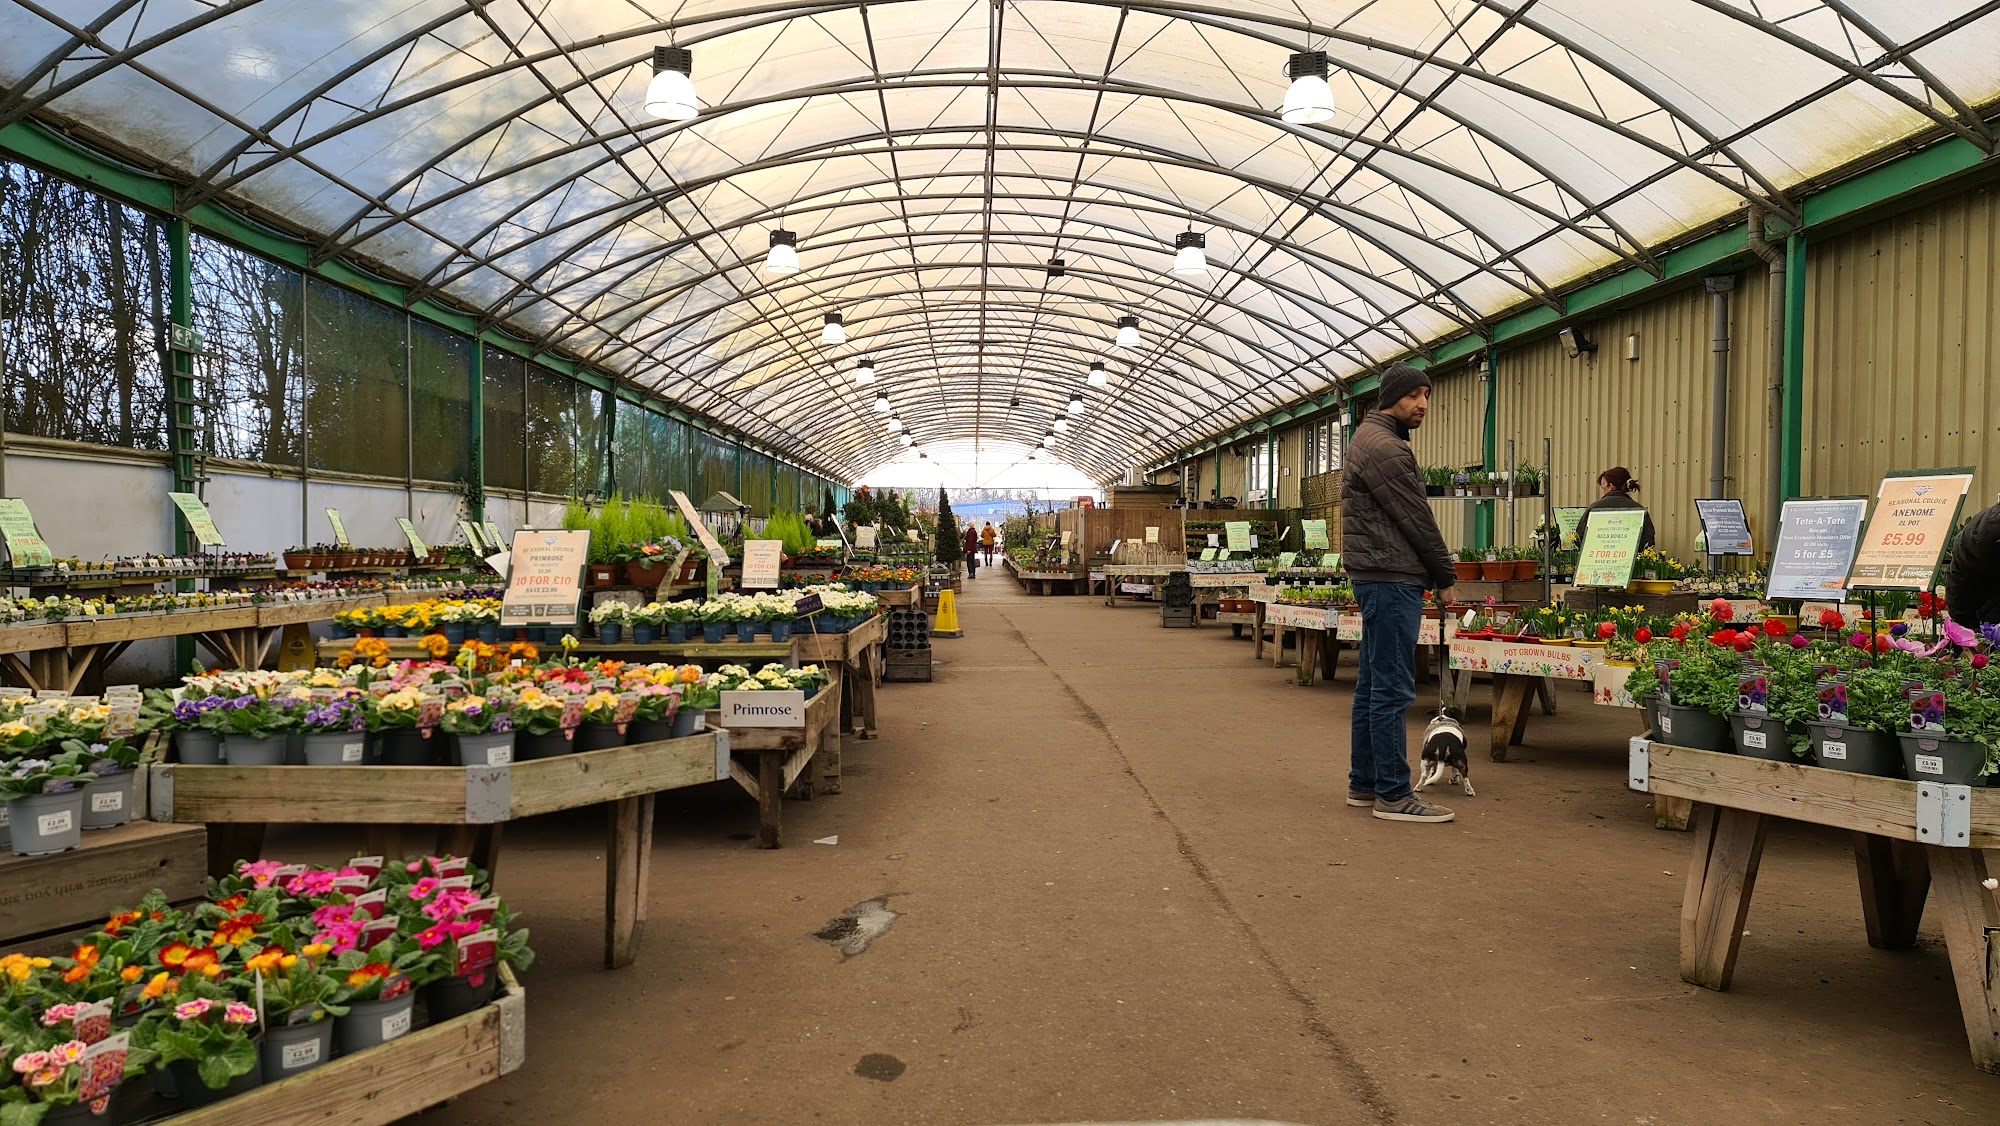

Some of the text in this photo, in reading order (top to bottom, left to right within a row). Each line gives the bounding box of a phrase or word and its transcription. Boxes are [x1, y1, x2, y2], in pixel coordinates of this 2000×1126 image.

[1888, 497, 1947, 507] SEASONAL COLOUR
[1892, 508, 1935, 517] ANENOME
[1795, 517, 1846, 526] Tete-A-Tete
[1882, 533, 1926, 546] £5.99
[1595, 550, 1611, 558] FOR
[1612, 550, 1627, 558] £10
[1793, 549, 1834, 559] 5 for £5
[516, 576, 572, 586] 10 FOR £10
[1421, 623, 1434, 631] LBS
[1453, 643, 1476, 654] BULBS
[1503, 648, 1572, 662] POT GROWN BULBS
[733, 703, 792, 715] Primrose
[25, 886, 50, 901] you
